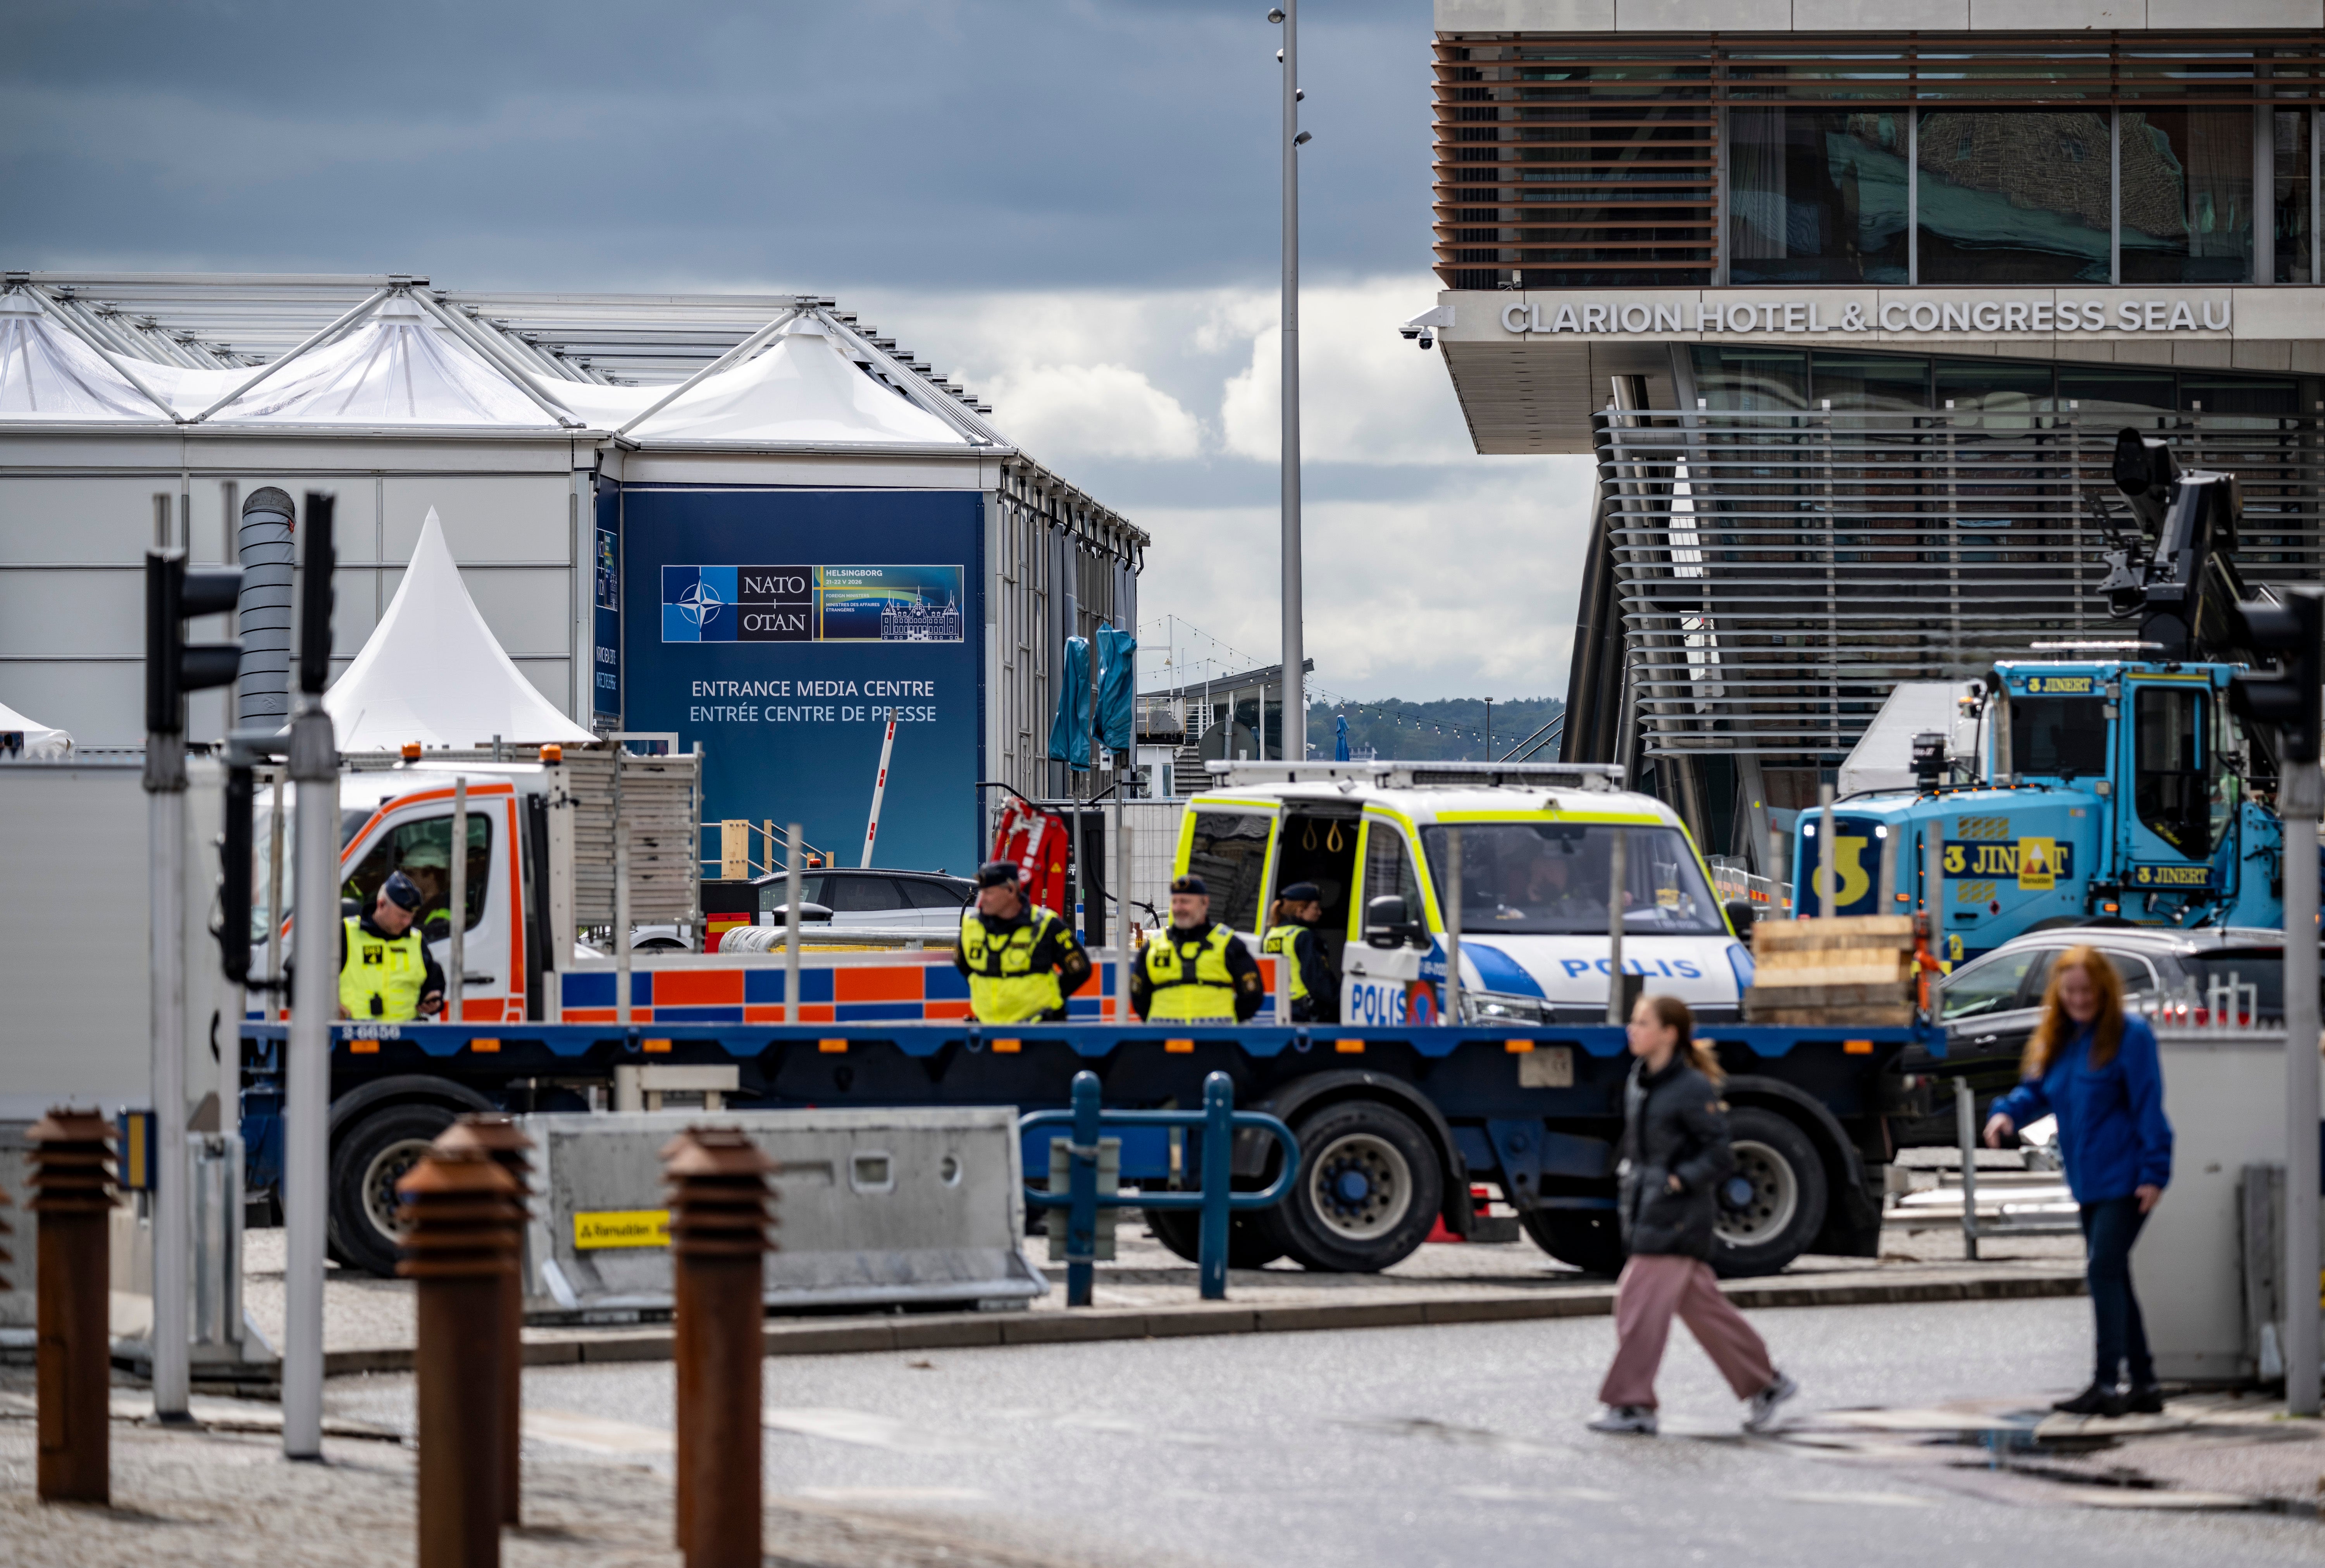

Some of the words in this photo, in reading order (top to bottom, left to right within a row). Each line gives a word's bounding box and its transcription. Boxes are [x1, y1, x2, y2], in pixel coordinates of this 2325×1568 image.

[1501, 302, 1682, 333] CLARION
[1697, 302, 1829, 332] HOTEL
[1841, 301, 1867, 332] &
[1879, 301, 2105, 331] CONGRESS
[744, 576, 805, 594] NATO
[744, 614, 806, 631] OTAN
[692, 681, 790, 697] ENTRANCE
[797, 681, 858, 697] MEDIA
[864, 681, 934, 697] CENTRE
[2043, 678, 2092, 692] JINERT
[690, 702, 758, 722] ENTRÉE
[765, 706, 835, 722] CENTRE
[842, 706, 865, 721] DE
[871, 706, 936, 722] PRESSE
[1972, 845, 2068, 874] JINT
[2153, 867, 2208, 884] JINERT
[1560, 958, 1702, 978] POLIS
[1352, 983, 1406, 1025] POLIS
